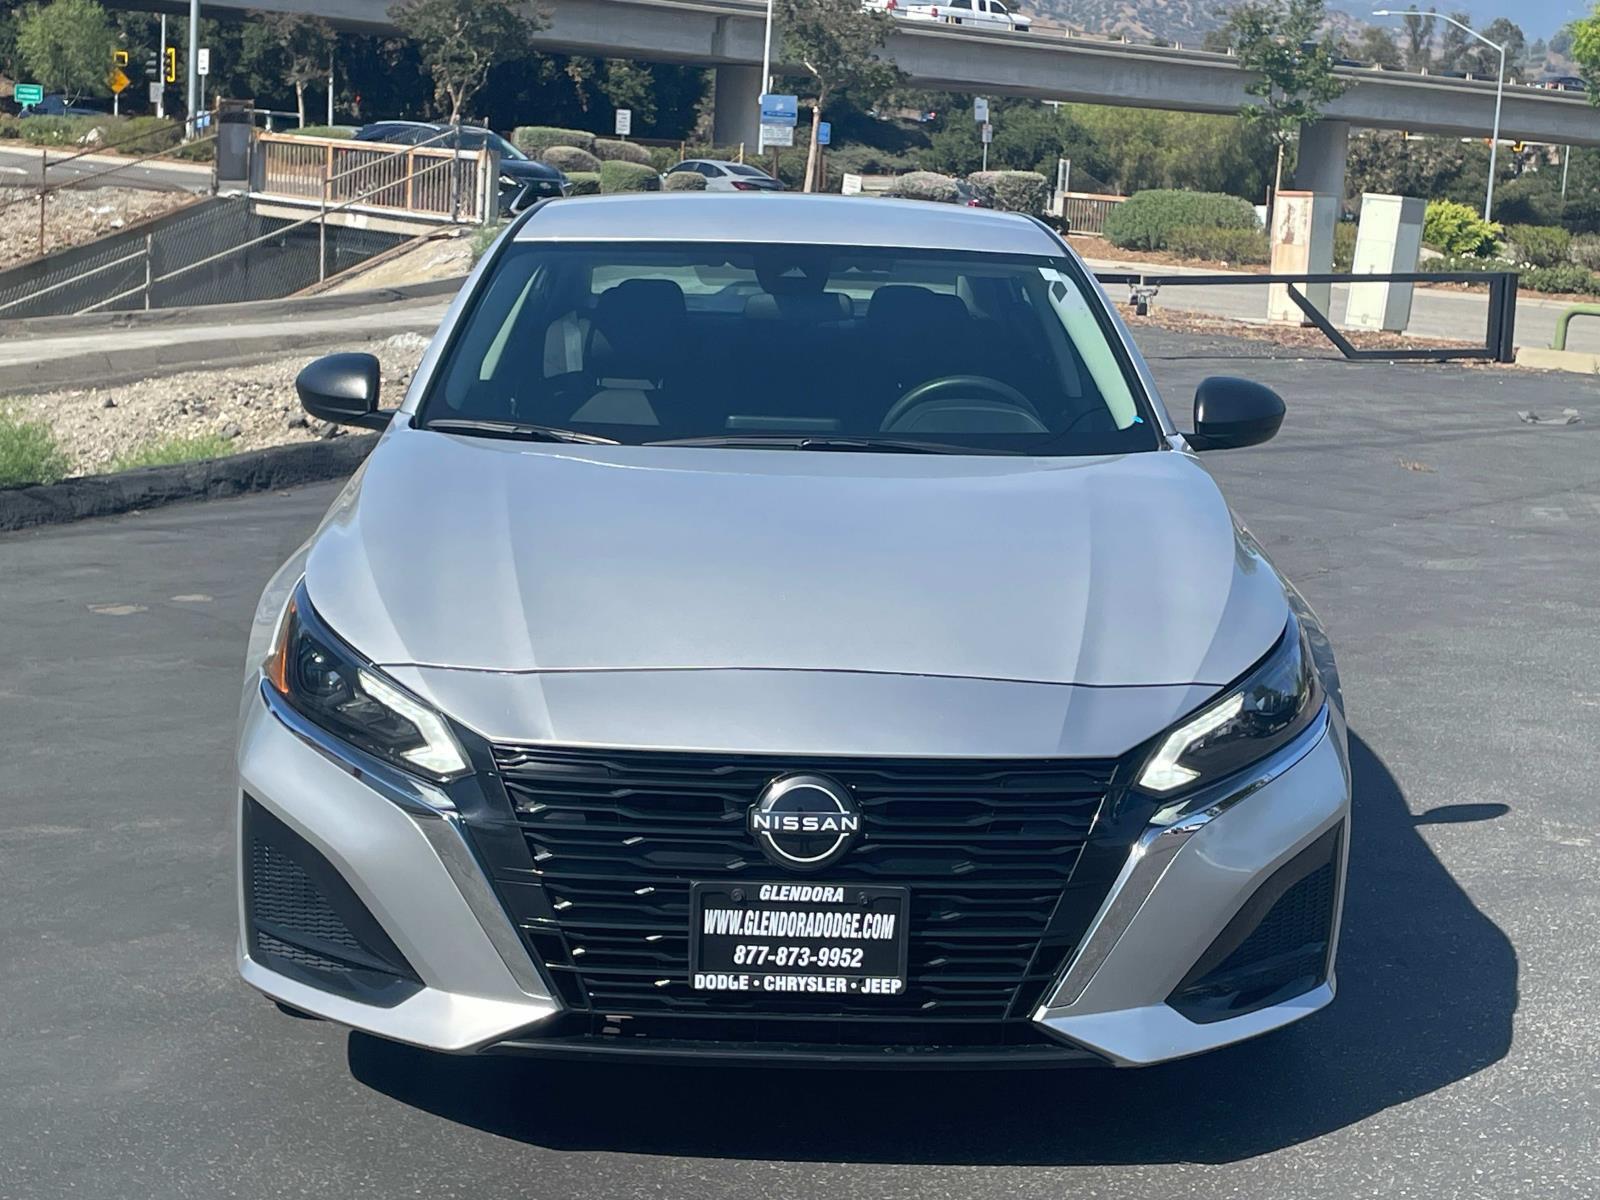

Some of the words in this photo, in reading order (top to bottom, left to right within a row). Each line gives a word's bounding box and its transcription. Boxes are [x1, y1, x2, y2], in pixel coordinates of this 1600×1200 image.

[753, 814, 858, 831] NISSAN
[759, 884, 845, 903] GLENDORA
[703, 909, 896, 940] WWW.GLENDORADODGE.COM
[733, 945, 864, 968] 877-873-9952
[694, 974, 749, 991] DODGE
[763, 975, 847, 993] CHRYSLER
[860, 978, 902, 994] JEEP
